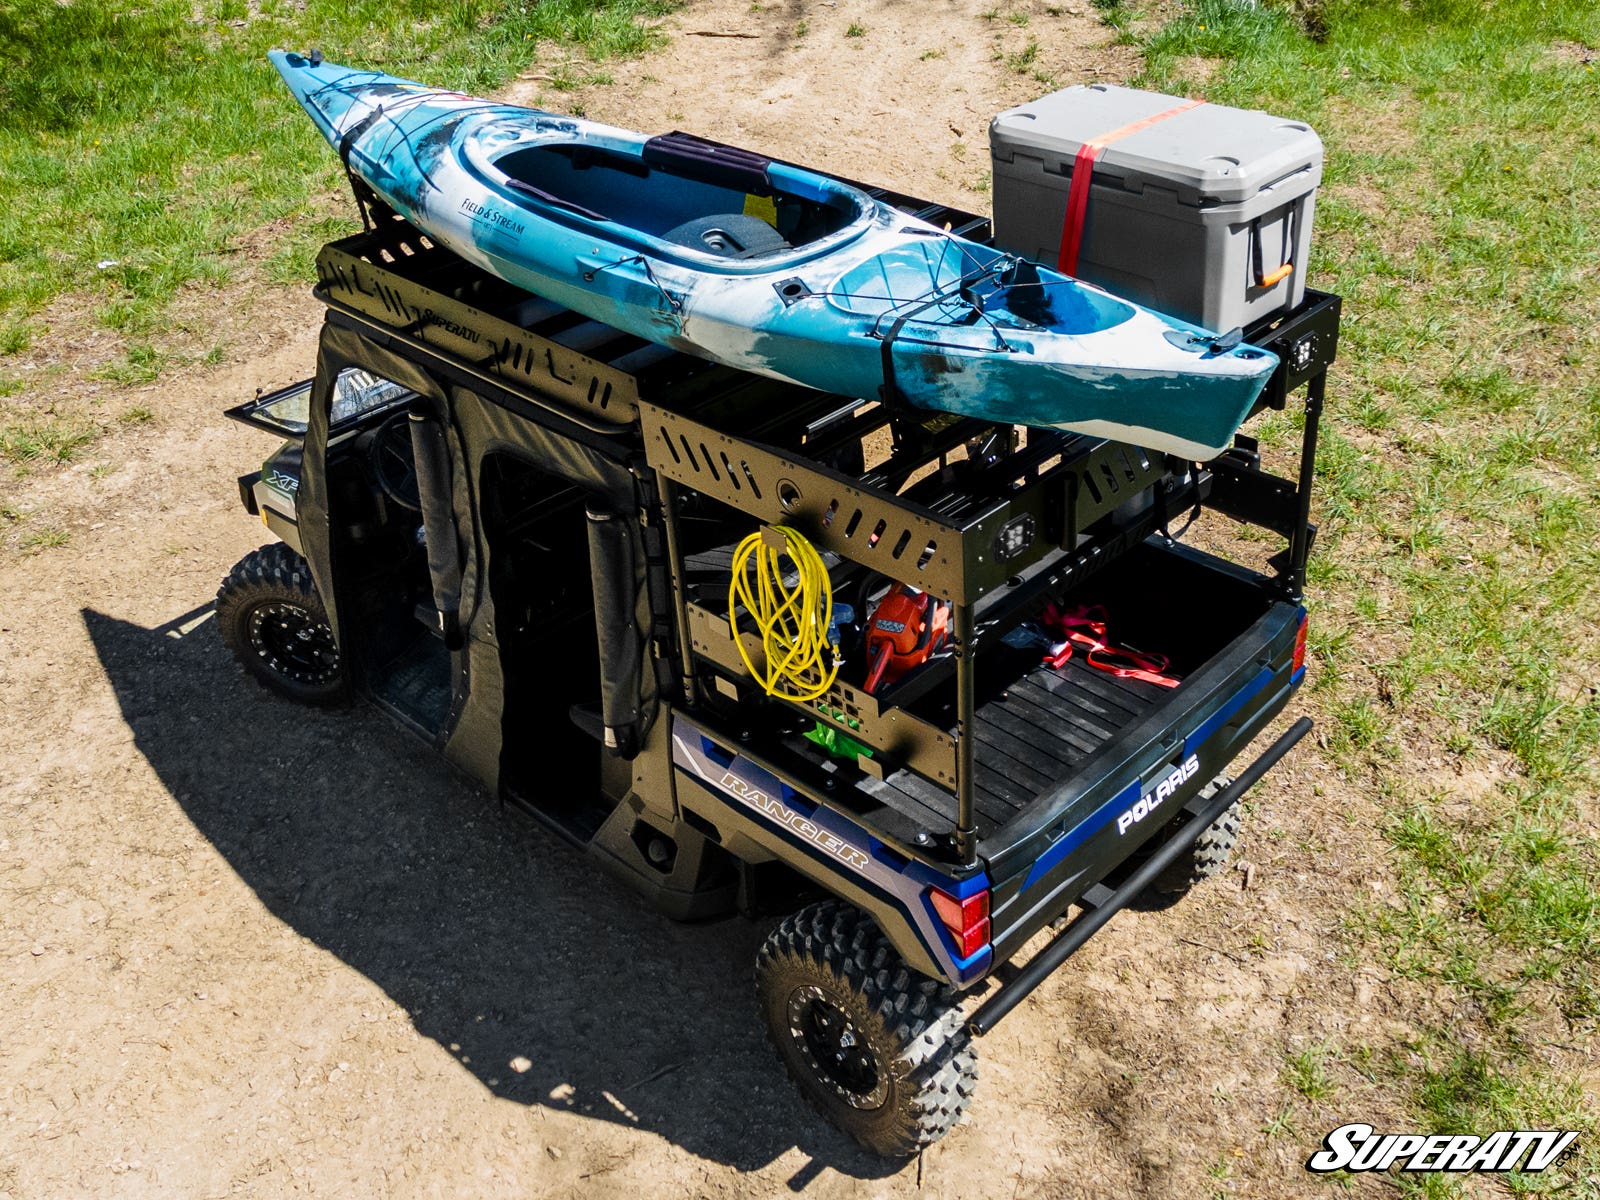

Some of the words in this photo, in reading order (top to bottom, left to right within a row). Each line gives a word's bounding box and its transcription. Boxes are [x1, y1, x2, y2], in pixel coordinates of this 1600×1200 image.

[461, 197, 485, 215] FIELD
[483, 208, 493, 219] &
[490, 211, 526, 235] STREAM
[720, 772, 869, 871] RANGER
[1117, 753, 1200, 836] POLARIS
